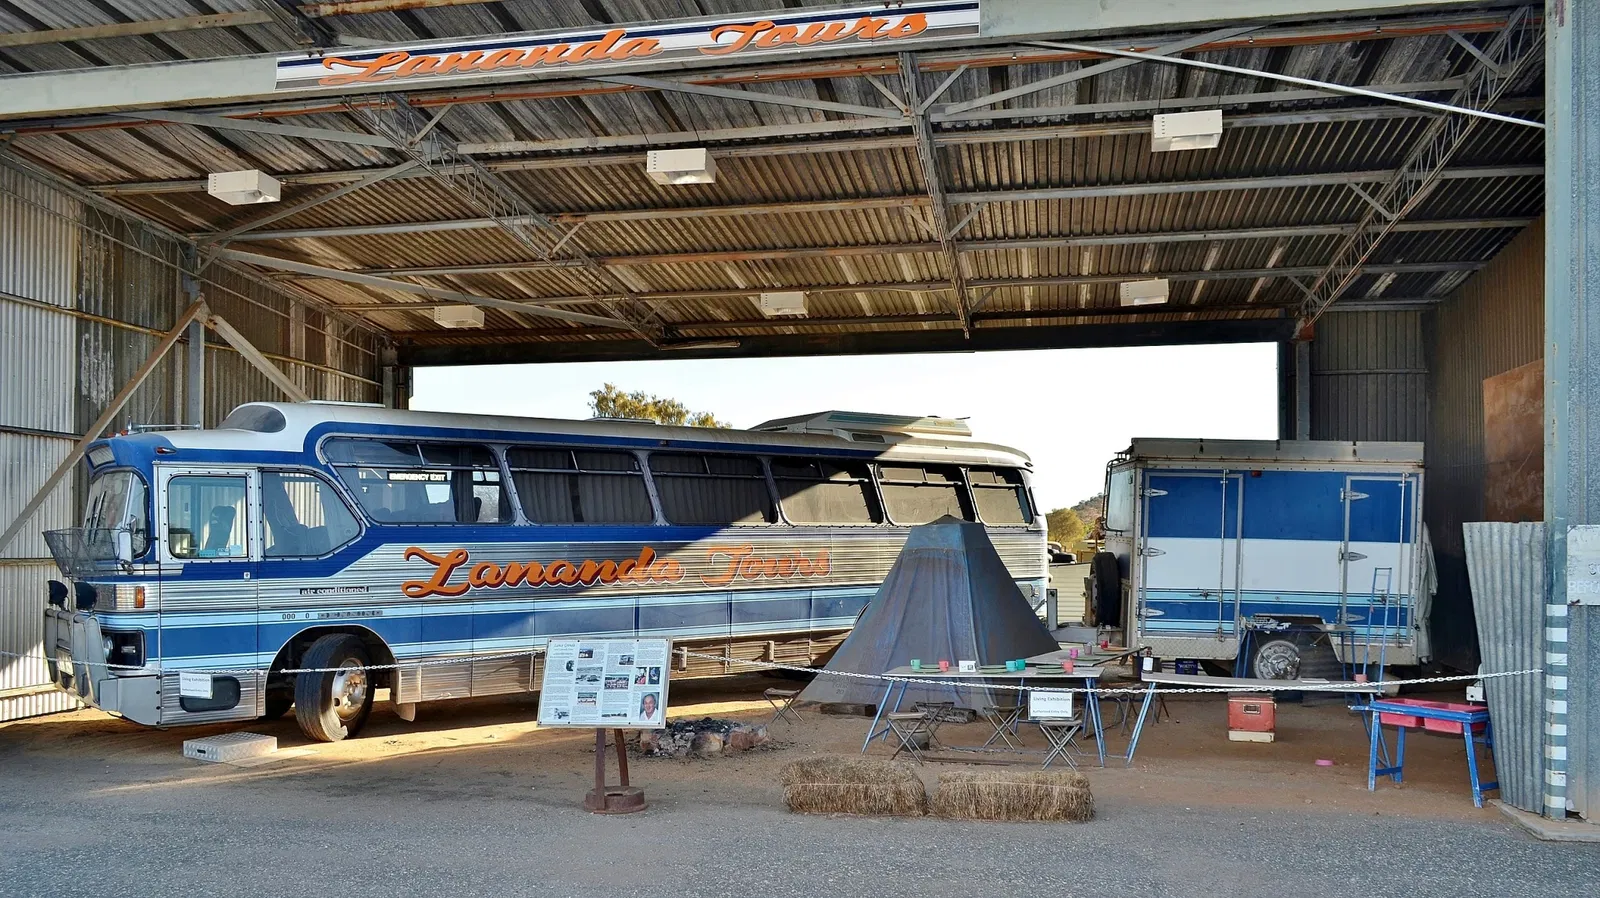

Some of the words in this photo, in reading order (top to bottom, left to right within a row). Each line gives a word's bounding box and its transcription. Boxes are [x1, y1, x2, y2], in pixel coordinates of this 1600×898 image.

[318, 29, 663, 86] Lananda
[698, 13, 928, 55] Tours
[389, 473, 429, 481] EMERGENCY
[430, 474, 446, 482] EXIT
[401, 546, 686, 598] Lananda
[700, 543, 832, 589] Tours
[317, 586, 367, 595] conditioned
